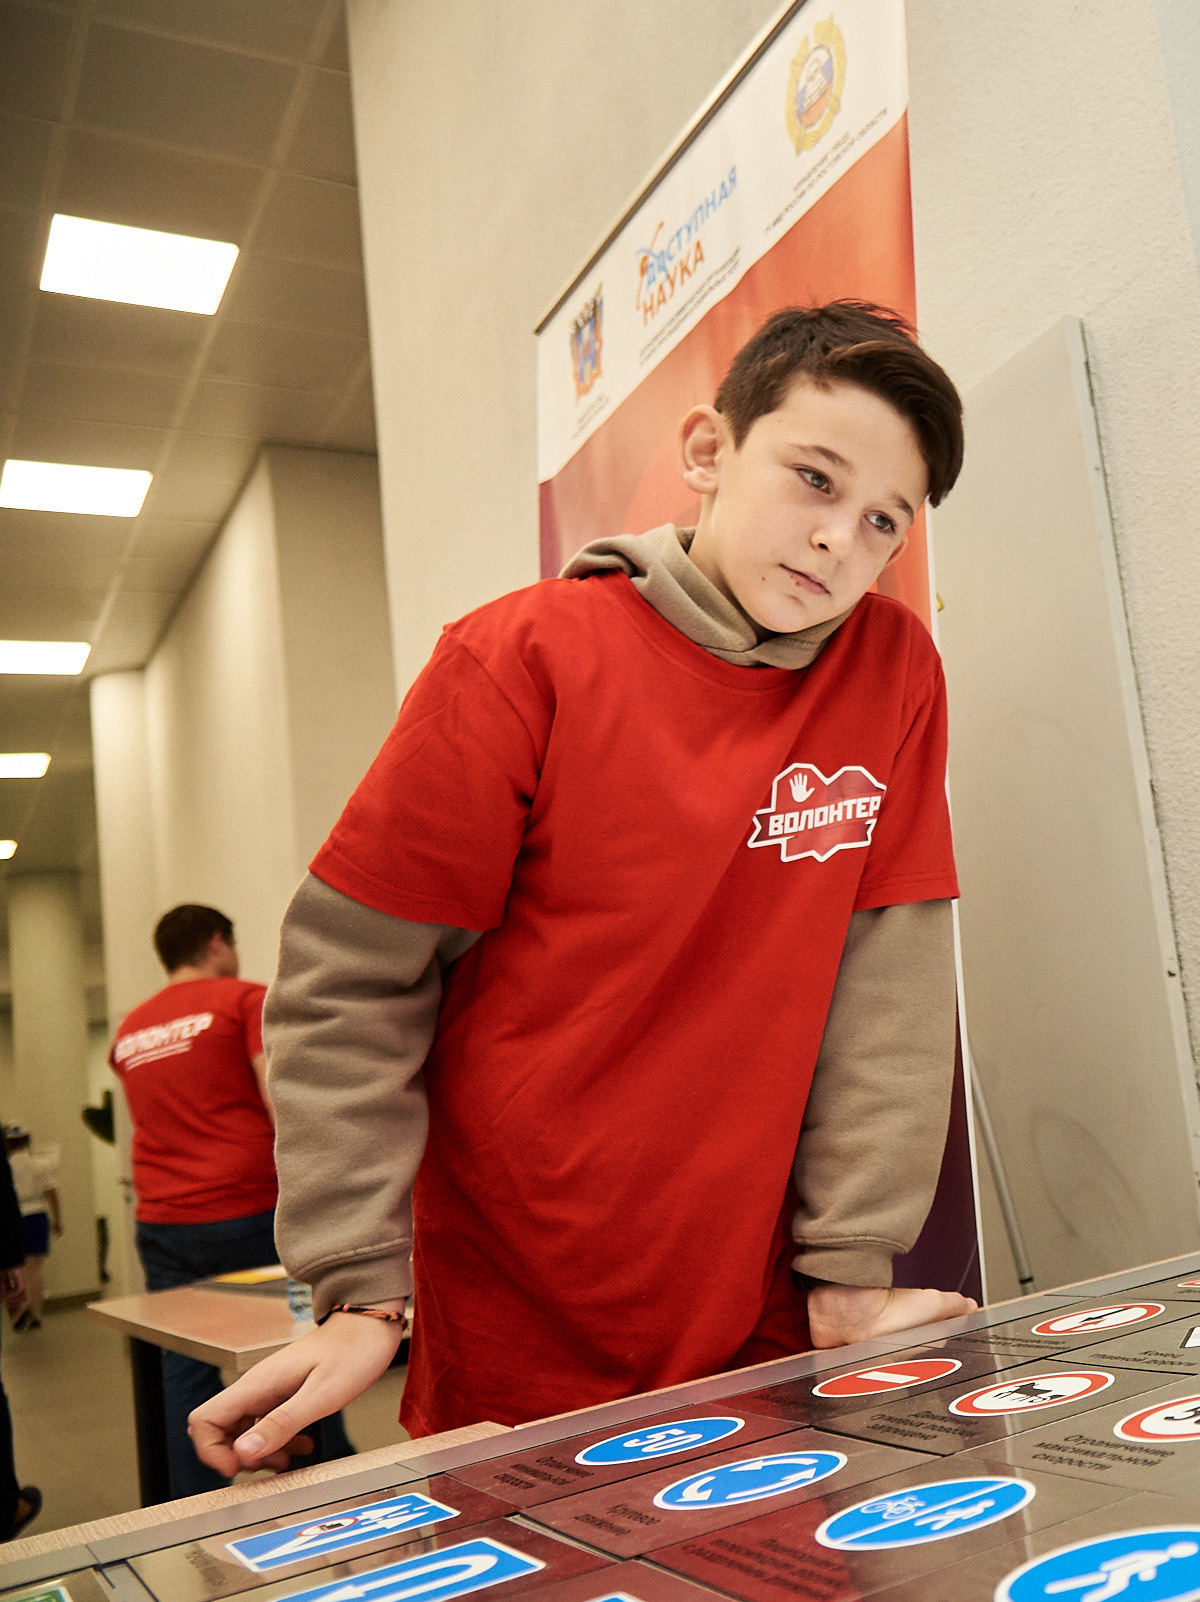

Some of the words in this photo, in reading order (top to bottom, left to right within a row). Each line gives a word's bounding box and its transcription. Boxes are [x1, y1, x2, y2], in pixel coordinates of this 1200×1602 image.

[643, 165, 738, 290] ДОСТУПНАЯ
[642, 239, 705, 327] НАУКА
[768, 796, 882, 837] ВОЛОНТЕР
[622, 1429, 704, 1453] 50
[1032, 1441, 1162, 1467] максимальной
[1063, 1434, 1176, 1457] Ограничение
[1031, 1452, 1112, 1471] скорости
